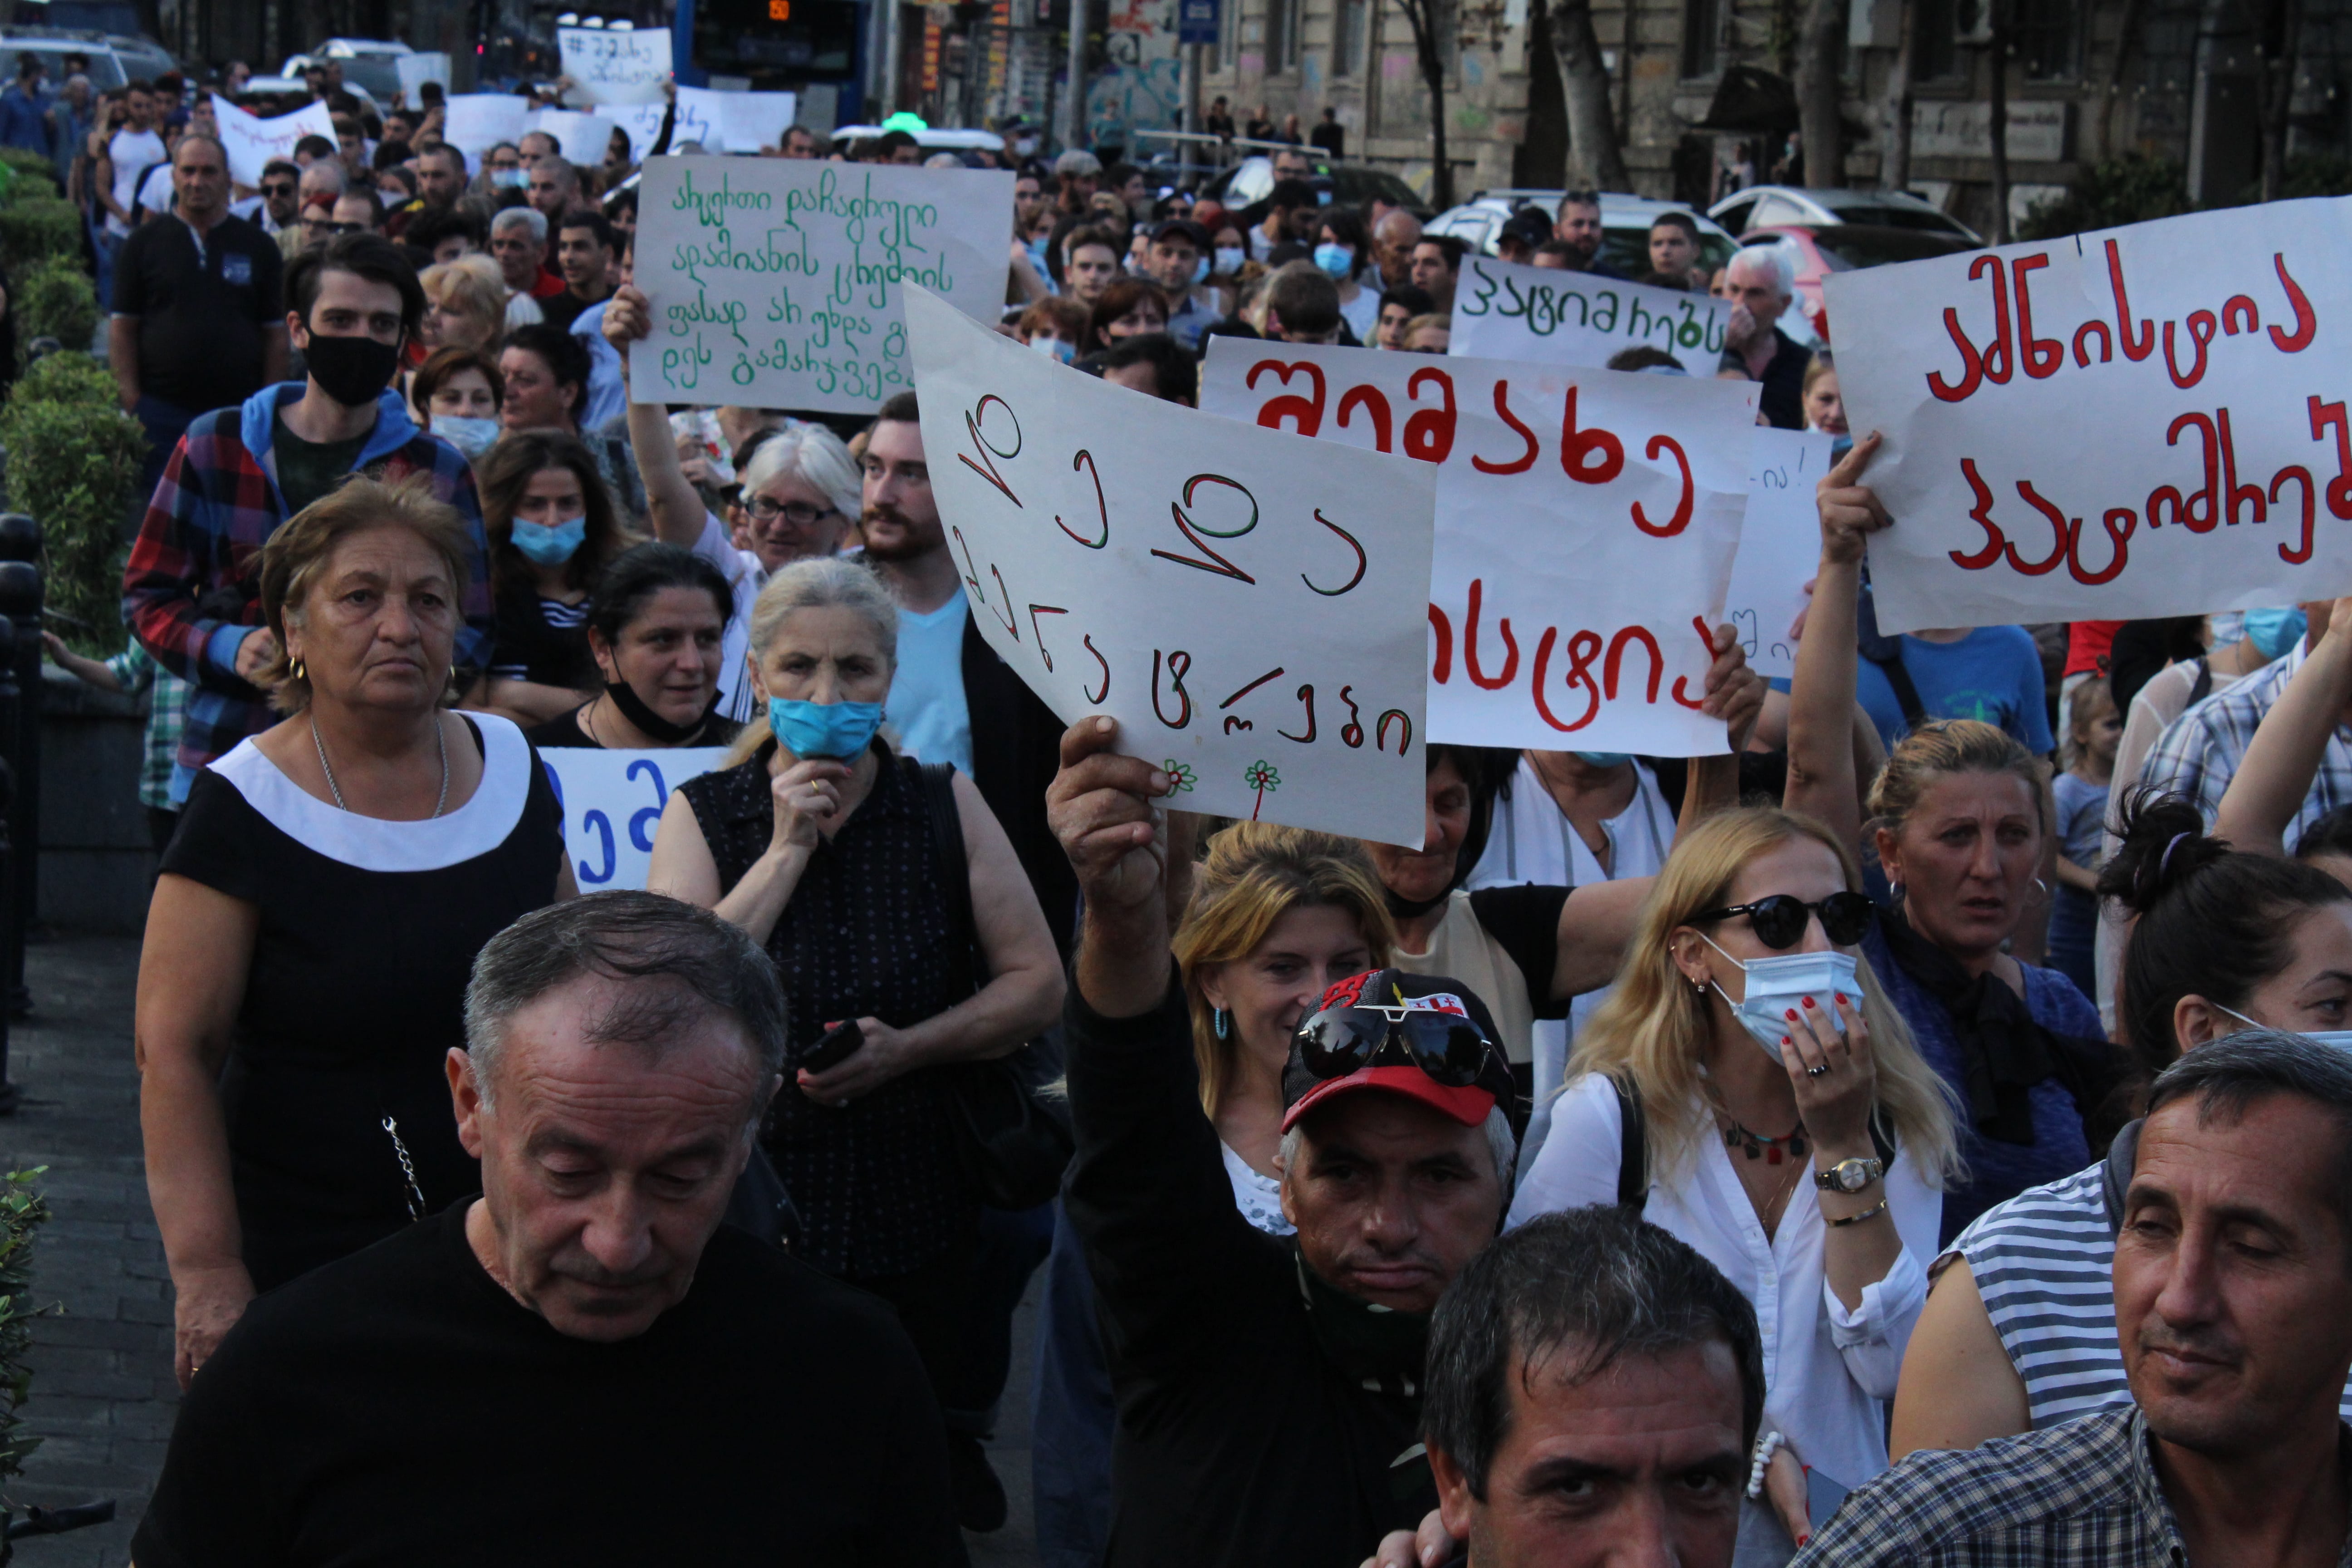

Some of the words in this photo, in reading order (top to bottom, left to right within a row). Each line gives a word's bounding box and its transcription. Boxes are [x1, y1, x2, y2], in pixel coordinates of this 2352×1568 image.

[672, 169, 771, 227] არცერთი
[784, 168, 937, 253] დაჩაგრული
[672, 228, 819, 288] ადამიანის
[668, 288, 749, 347] ფასად
[767, 286, 802, 324] არ
[811, 294, 872, 357] უნდა
[1461, 261, 1724, 354] პატიმრებს
[1926, 239, 2317, 402] ამნისტია
[663, 332, 711, 389] დეს
[957, 394, 1367, 596] დედა
[951, 525, 1413, 757] მენატრები
